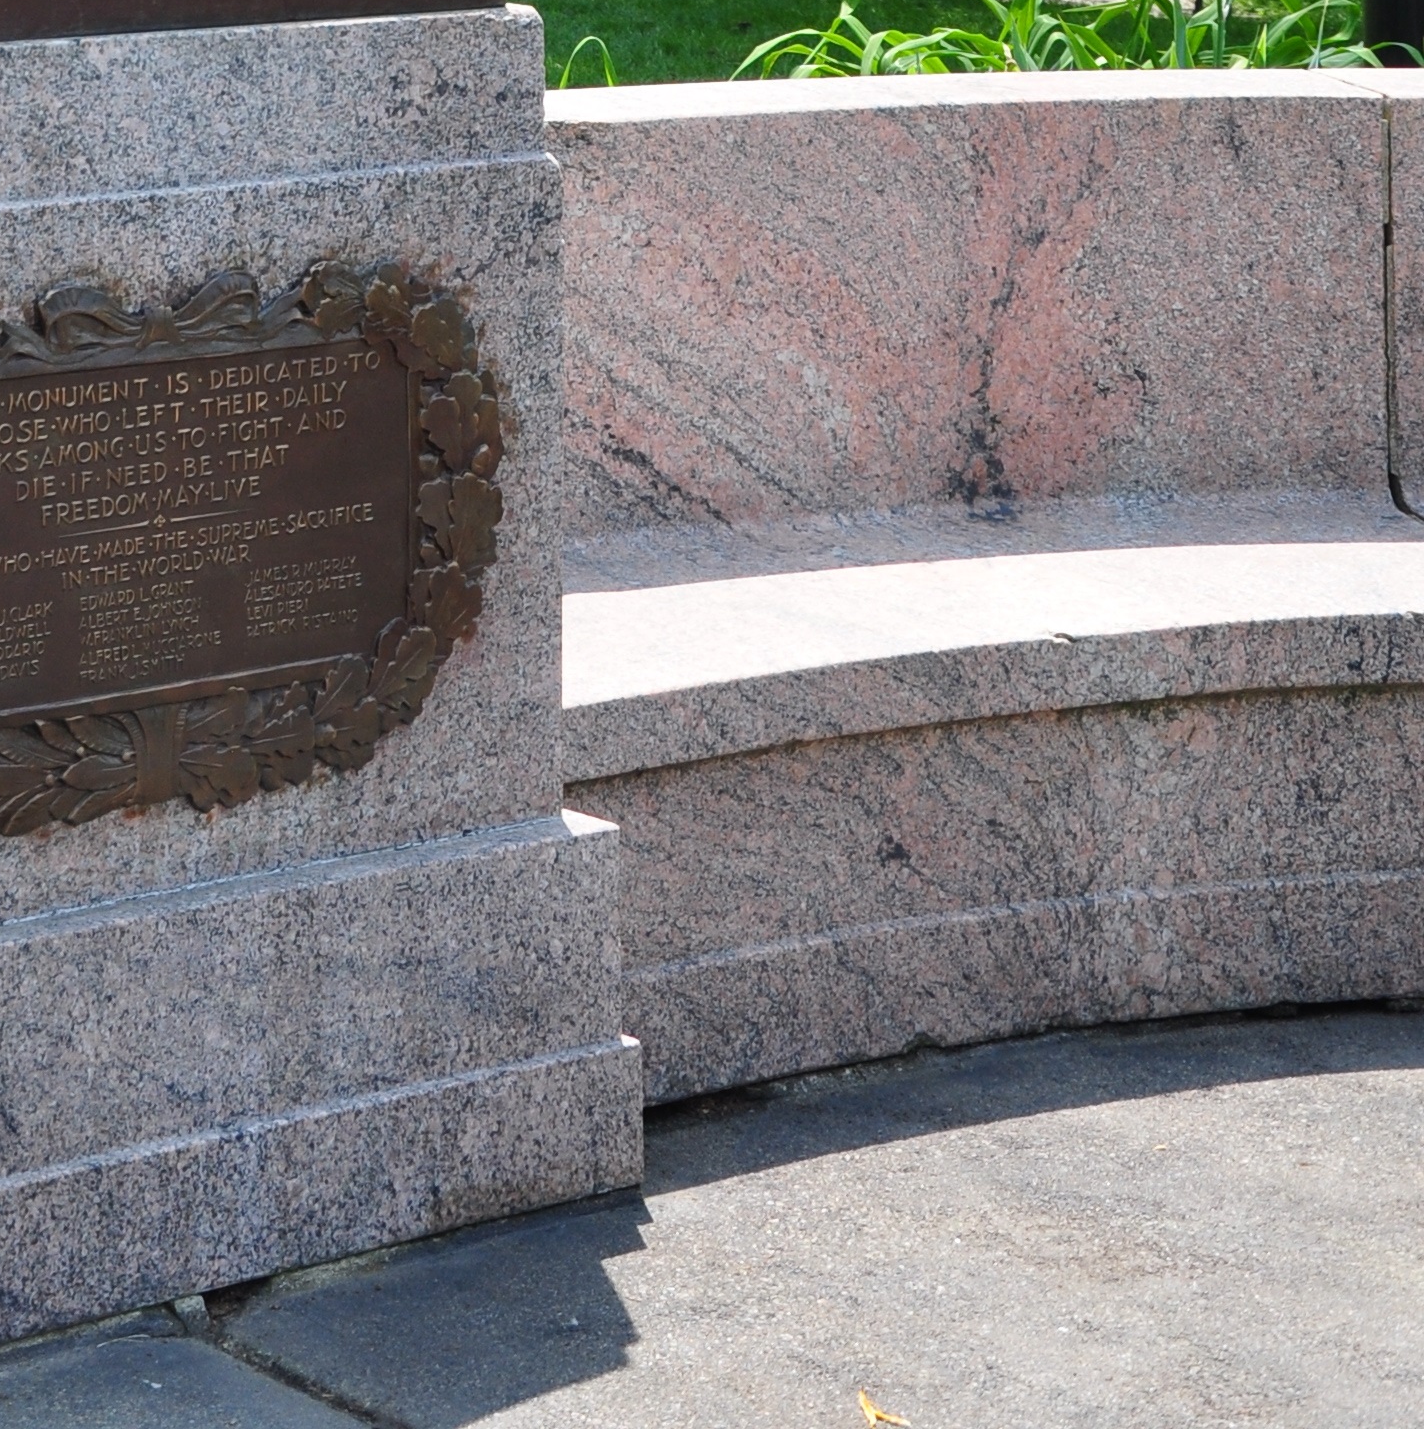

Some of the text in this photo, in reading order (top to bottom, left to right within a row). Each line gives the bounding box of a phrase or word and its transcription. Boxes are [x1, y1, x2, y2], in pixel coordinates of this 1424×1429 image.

[7, 378, 149, 414] MONUMENT
[166, 372, 190, 395] IS
[209, 356, 338, 390] DEDICATED
[348, 351, 381, 372] TO
[56, 411, 111, 435] WHO
[121, 401, 184, 430] LEFT
[200, 391, 269, 418] THEIR
[282, 381, 347, 409] DAILY
[38, 436, 124, 470] AMONG
[135, 430, 167, 456] US
[177, 427, 207, 451] TO
[218, 416, 283, 443] FIGHT
[296, 409, 347, 436] AND
[16, 444, 289, 502] DIE IF NEED BE THAT
[41, 475, 261, 527] FREEDOM MAY LIVE
[40, 545, 91, 568] HAVE
[96, 536, 146, 561] MADE
[151, 530, 188, 552] THE
[197, 517, 280, 547] SUPREME
[286, 502, 374, 534] SACRIFICE
[61, 544, 252, 590] IN THE WORLD WAR
[245, 564, 288, 589] JAMES
[317, 572, 363, 593] PATETE
[80, 589, 136, 612] EDWARD
[246, 597, 309, 621] LEVI PIERI
[78, 609, 129, 630] ALBERT
[161, 615, 200, 636] LYNCH
[246, 617, 297, 638] PATRICK
[78, 645, 130, 667] ALFRED
[0, 659, 40, 681] DAVIS
[80, 663, 128, 685] FRANK
